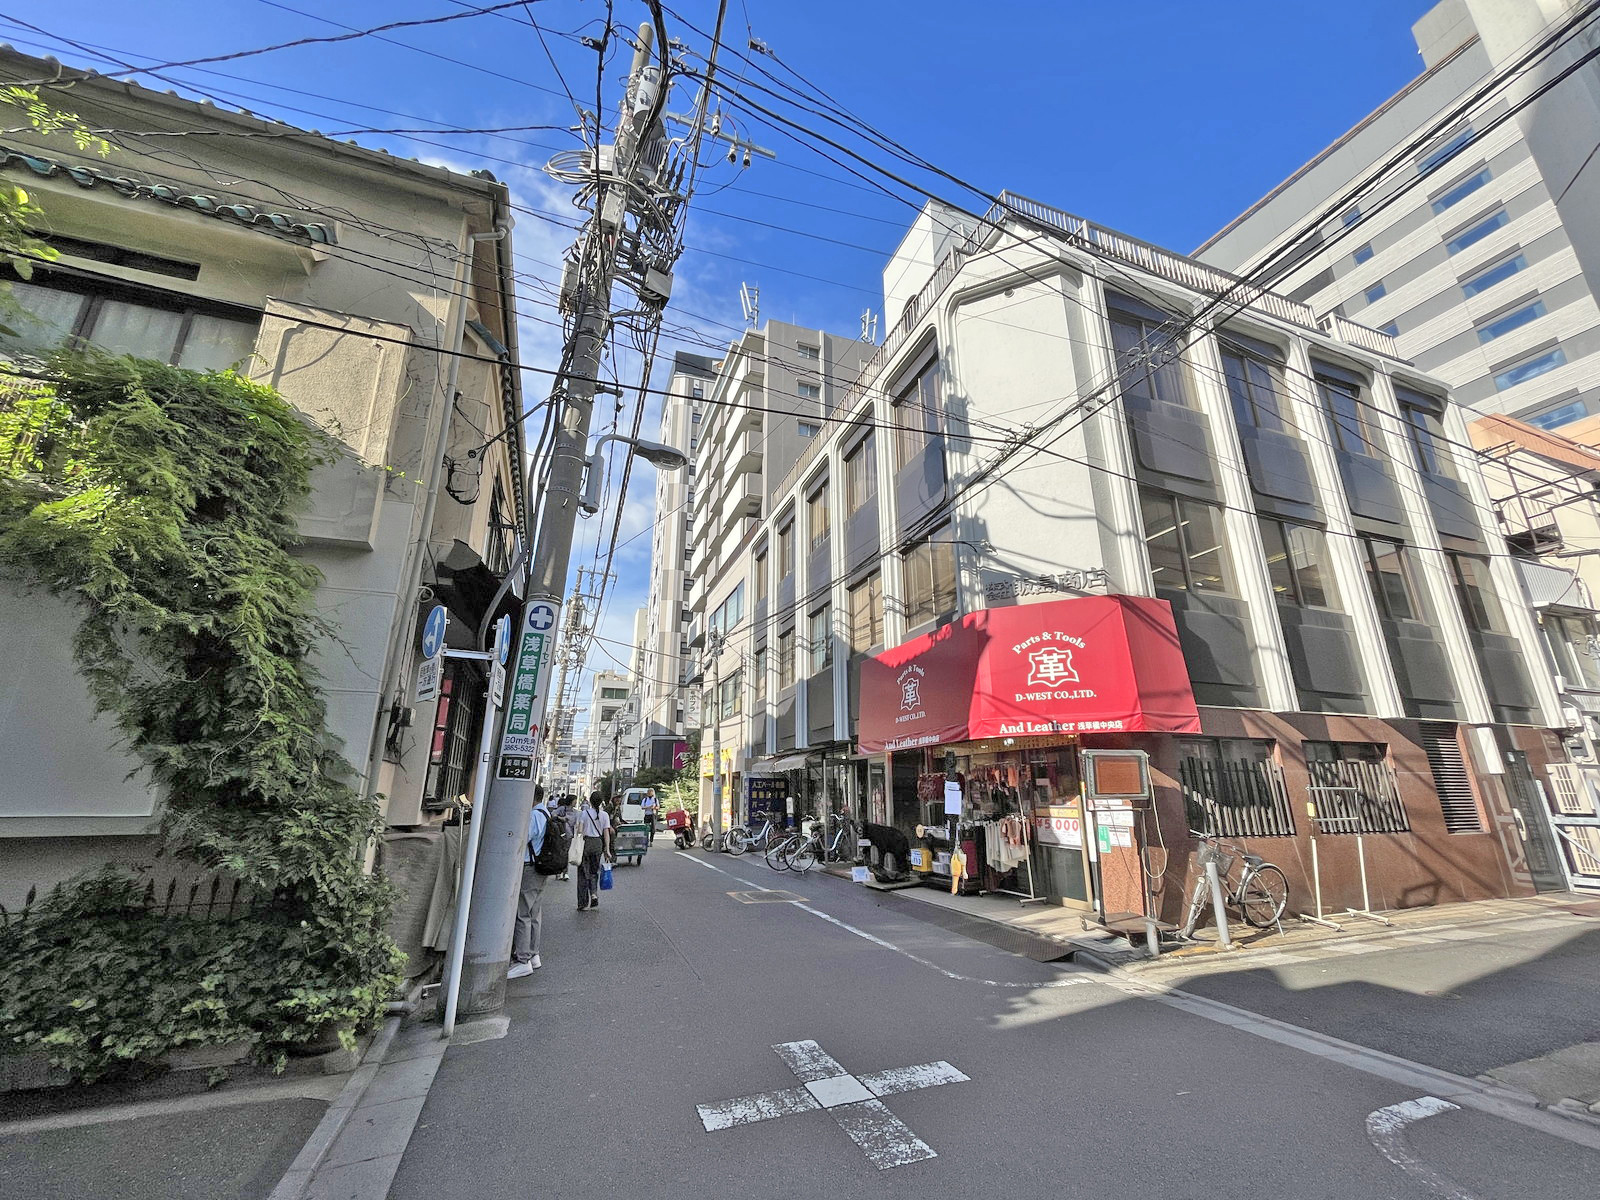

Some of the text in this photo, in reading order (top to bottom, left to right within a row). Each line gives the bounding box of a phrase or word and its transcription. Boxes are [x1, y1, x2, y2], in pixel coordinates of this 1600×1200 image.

[540, 634, 552, 669] コーセイ
[1012, 631, 1086, 654] Parts & Tools
[896, 669, 909, 686] Parts
[913, 664, 926, 677] Tools
[1034, 652, 1069, 681] 革
[509, 635, 541, 732] 浅草橋薬局
[904, 681, 917, 706] 革
[1015, 689, 1097, 702] D-WEST CO.,LTD.
[999, 722, 1025, 734] And
[1026, 720, 1075, 732] Leather
[884, 739, 896, 750] And
[896, 736, 918, 748] Leather
[505, 768, 526, 776] 1-24
